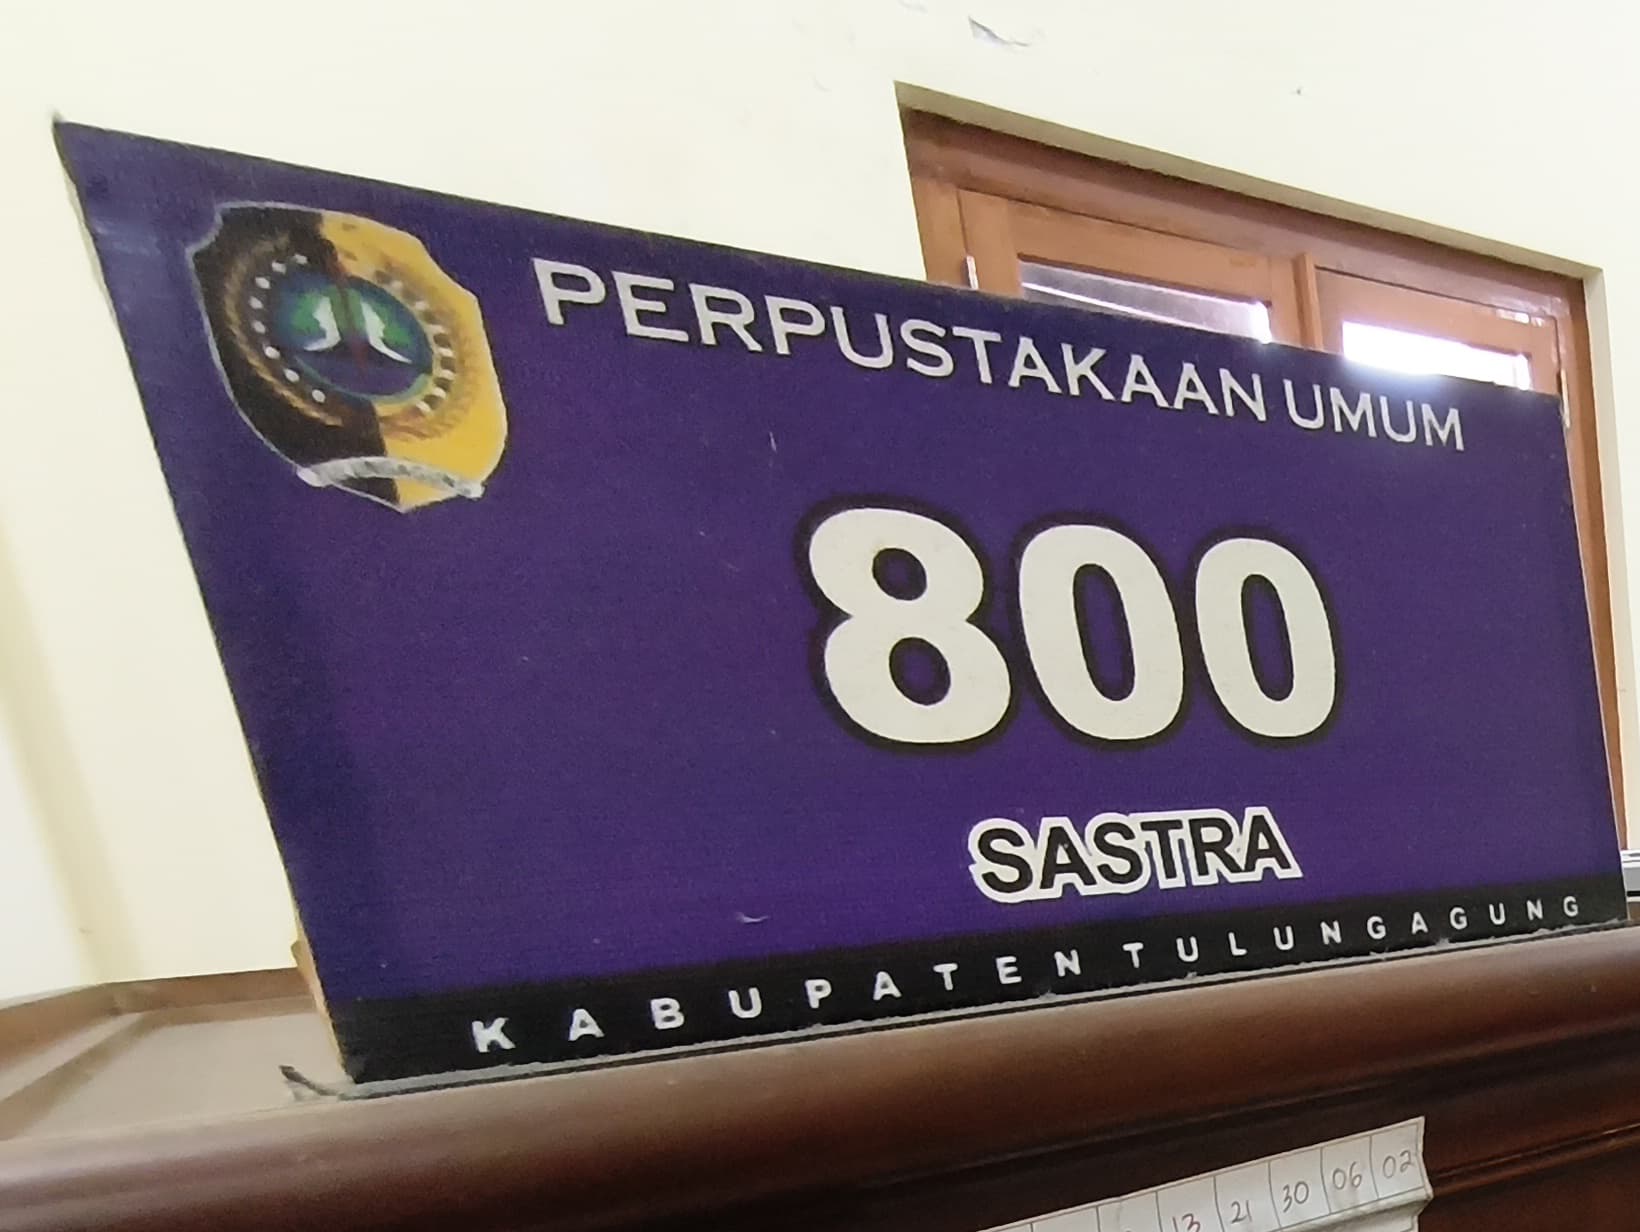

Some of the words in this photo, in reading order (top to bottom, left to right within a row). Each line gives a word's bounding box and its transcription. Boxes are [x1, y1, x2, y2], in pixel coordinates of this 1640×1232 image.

[531, 256, 1267, 422] PERPUSTAKAAN
[1282, 378, 1465, 452] UMUM
[807, 506, 1337, 745] 800
[969, 807, 1302, 903] SASTRA
[470, 948, 1081, 1054] KABUPATEN
[1121, 895, 1580, 968] TULUNGAGUNG
[1229, 1199, 1253, 1224] 21
[1282, 1180, 1310, 1214] 30
[1331, 1160, 1363, 1191] 06
[1381, 1149, 1416, 1180] 02
